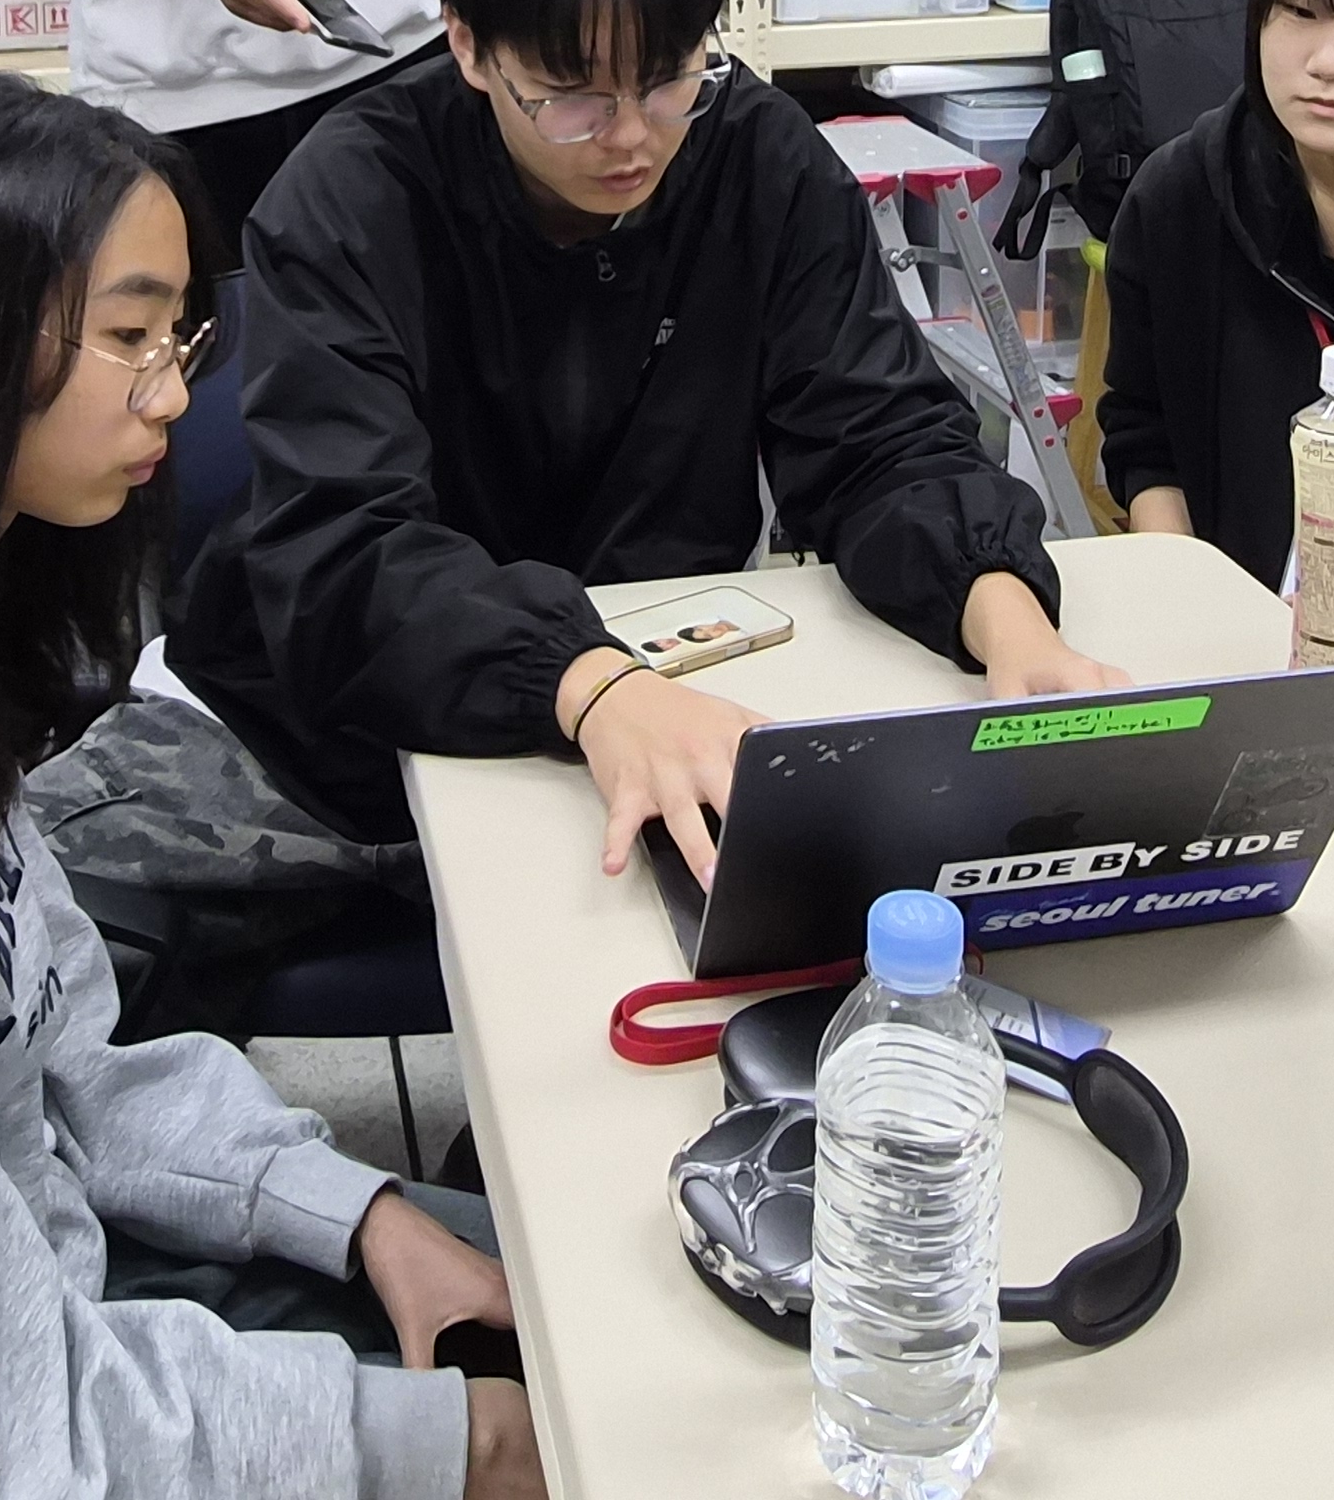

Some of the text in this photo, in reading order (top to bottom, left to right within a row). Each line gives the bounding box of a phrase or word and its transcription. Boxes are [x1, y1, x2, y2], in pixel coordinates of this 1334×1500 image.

[950, 828, 1306, 889] SIDE BY SIDE
[978, 894, 1132, 933] seoul
